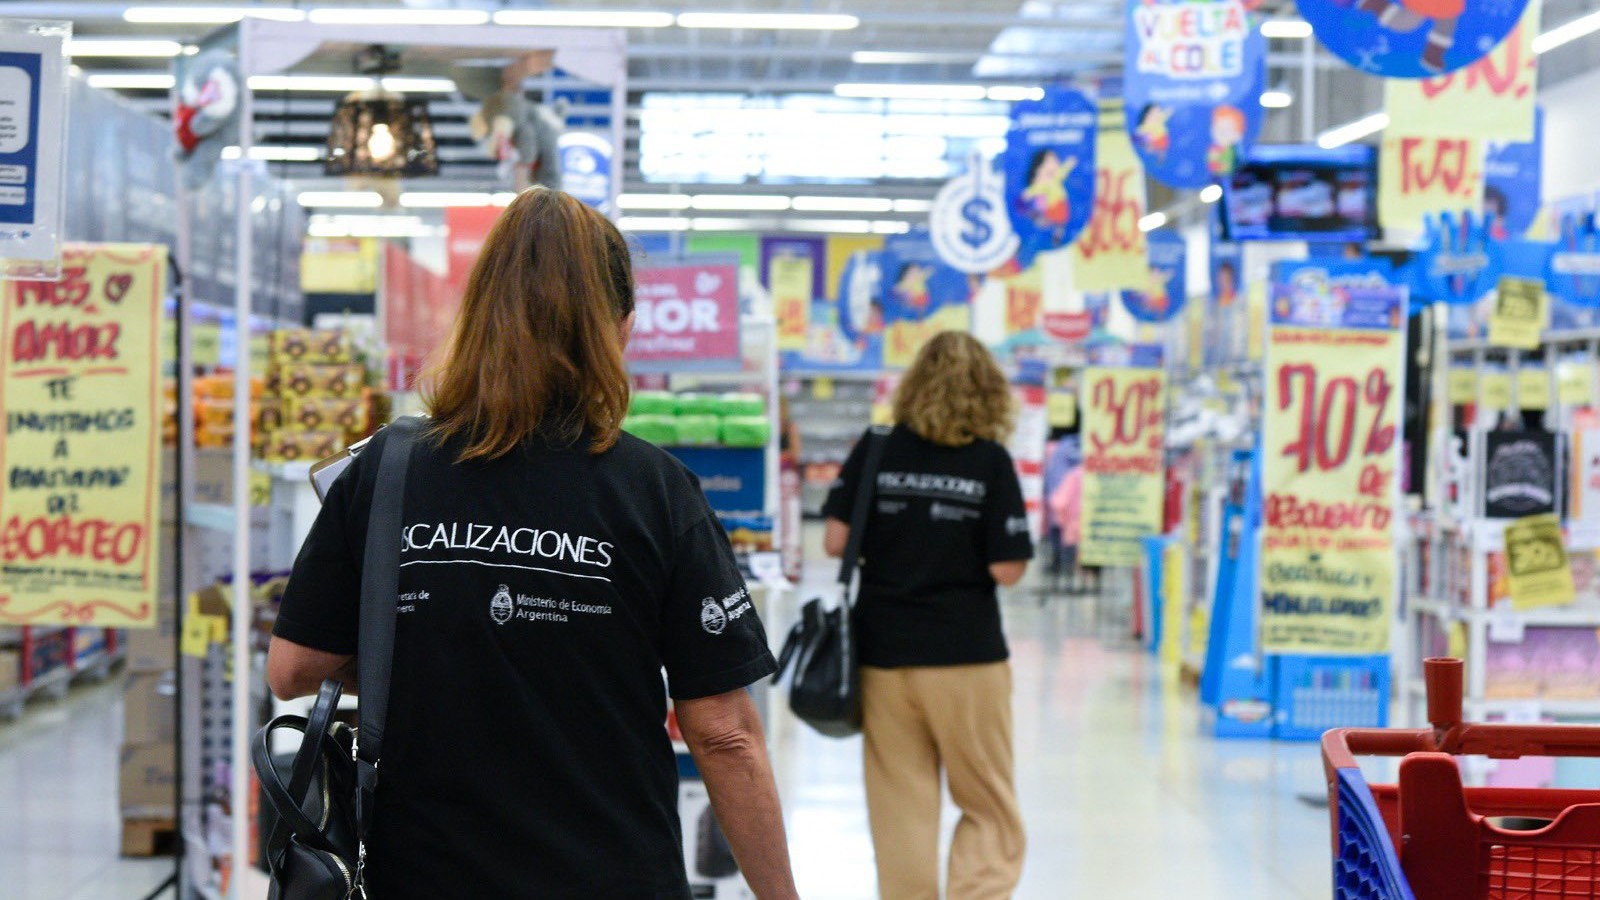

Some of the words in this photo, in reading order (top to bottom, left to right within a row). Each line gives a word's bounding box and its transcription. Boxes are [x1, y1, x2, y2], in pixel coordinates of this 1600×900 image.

[1139, 6, 1241, 40] VUELTA
[1170, 40, 1236, 72] COLE
[13, 319, 120, 363] AMOR
[1278, 362, 1397, 474] 70%
[0, 514, 143, 565] SORTEO
[401, 522, 614, 568] SCALIZACIONES
[418, 589, 430, 599] de
[516, 593, 557, 609] Ministerio
[559, 598, 570, 611] de
[571, 600, 613, 615] Economía
[516, 608, 568, 623] Argentina
